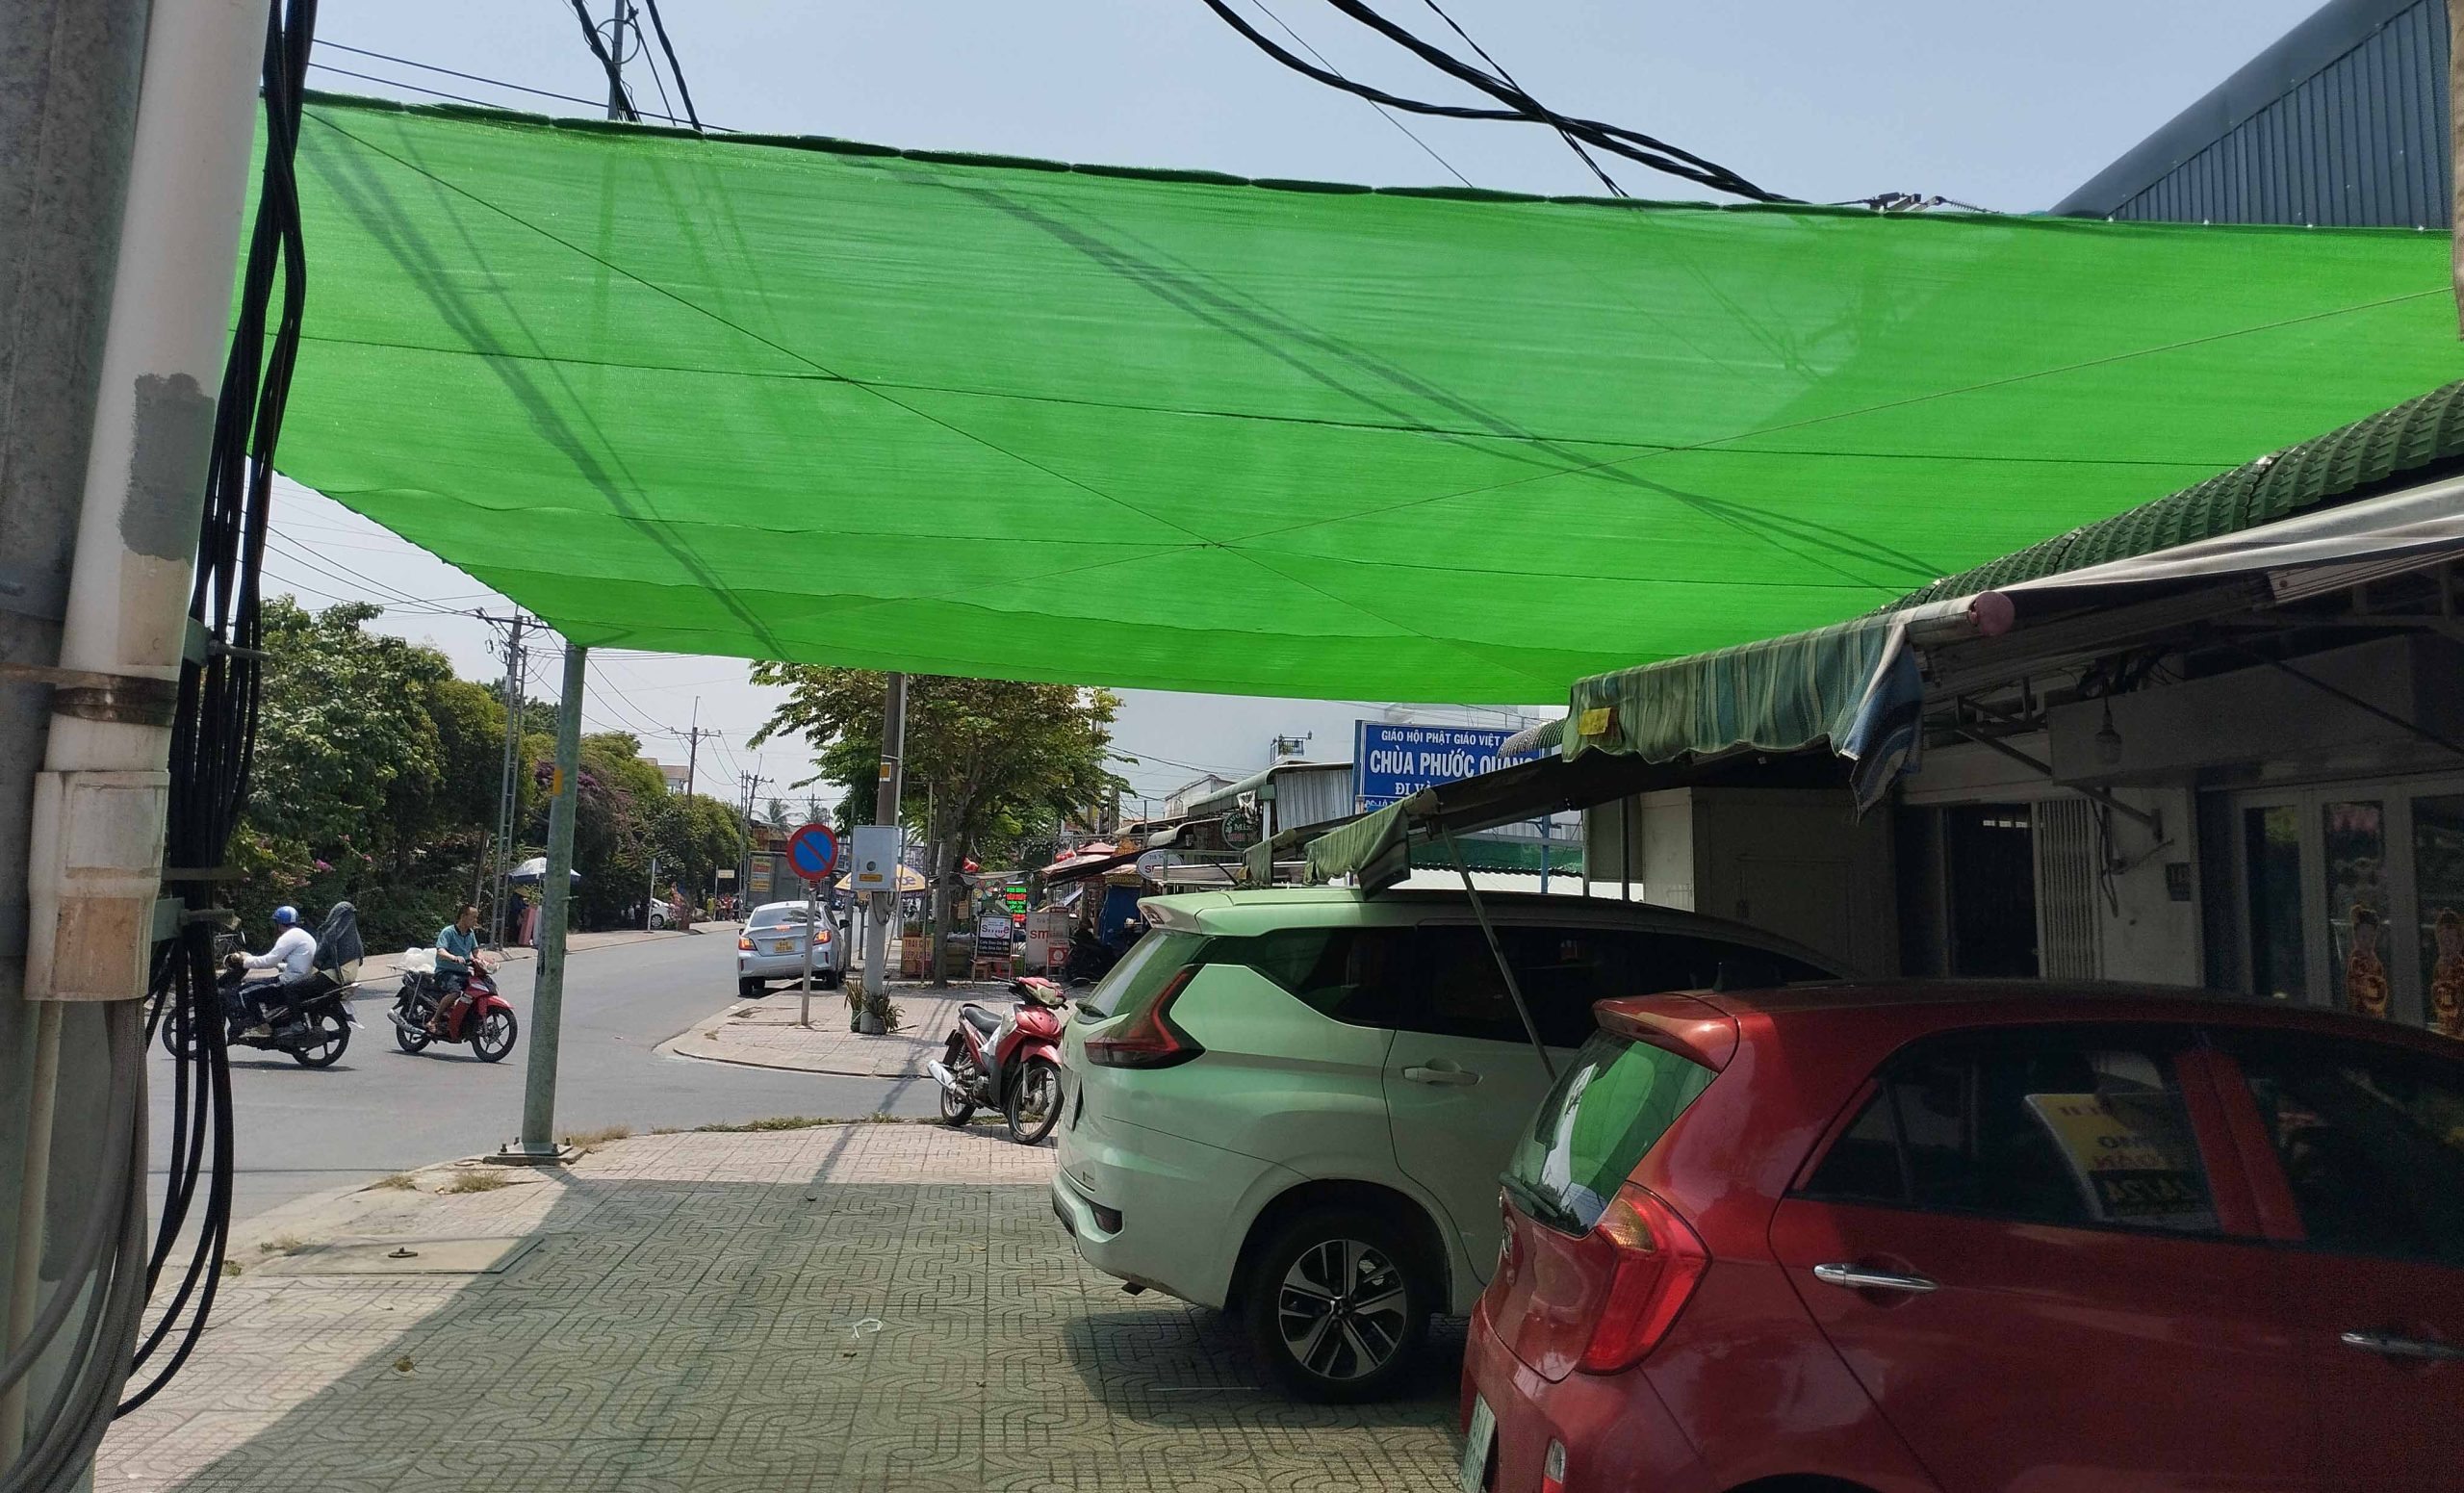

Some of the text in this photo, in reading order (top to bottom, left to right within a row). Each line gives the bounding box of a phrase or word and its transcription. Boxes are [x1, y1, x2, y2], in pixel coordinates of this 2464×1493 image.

[1381, 728, 1501, 748] GIÁO HỘI PHẬT GIÁO VIỆT
[1370, 745, 1415, 775] CHÙA
[1419, 748, 1476, 778] PHƯỚC
[1395, 782, 1411, 795] ĐI
